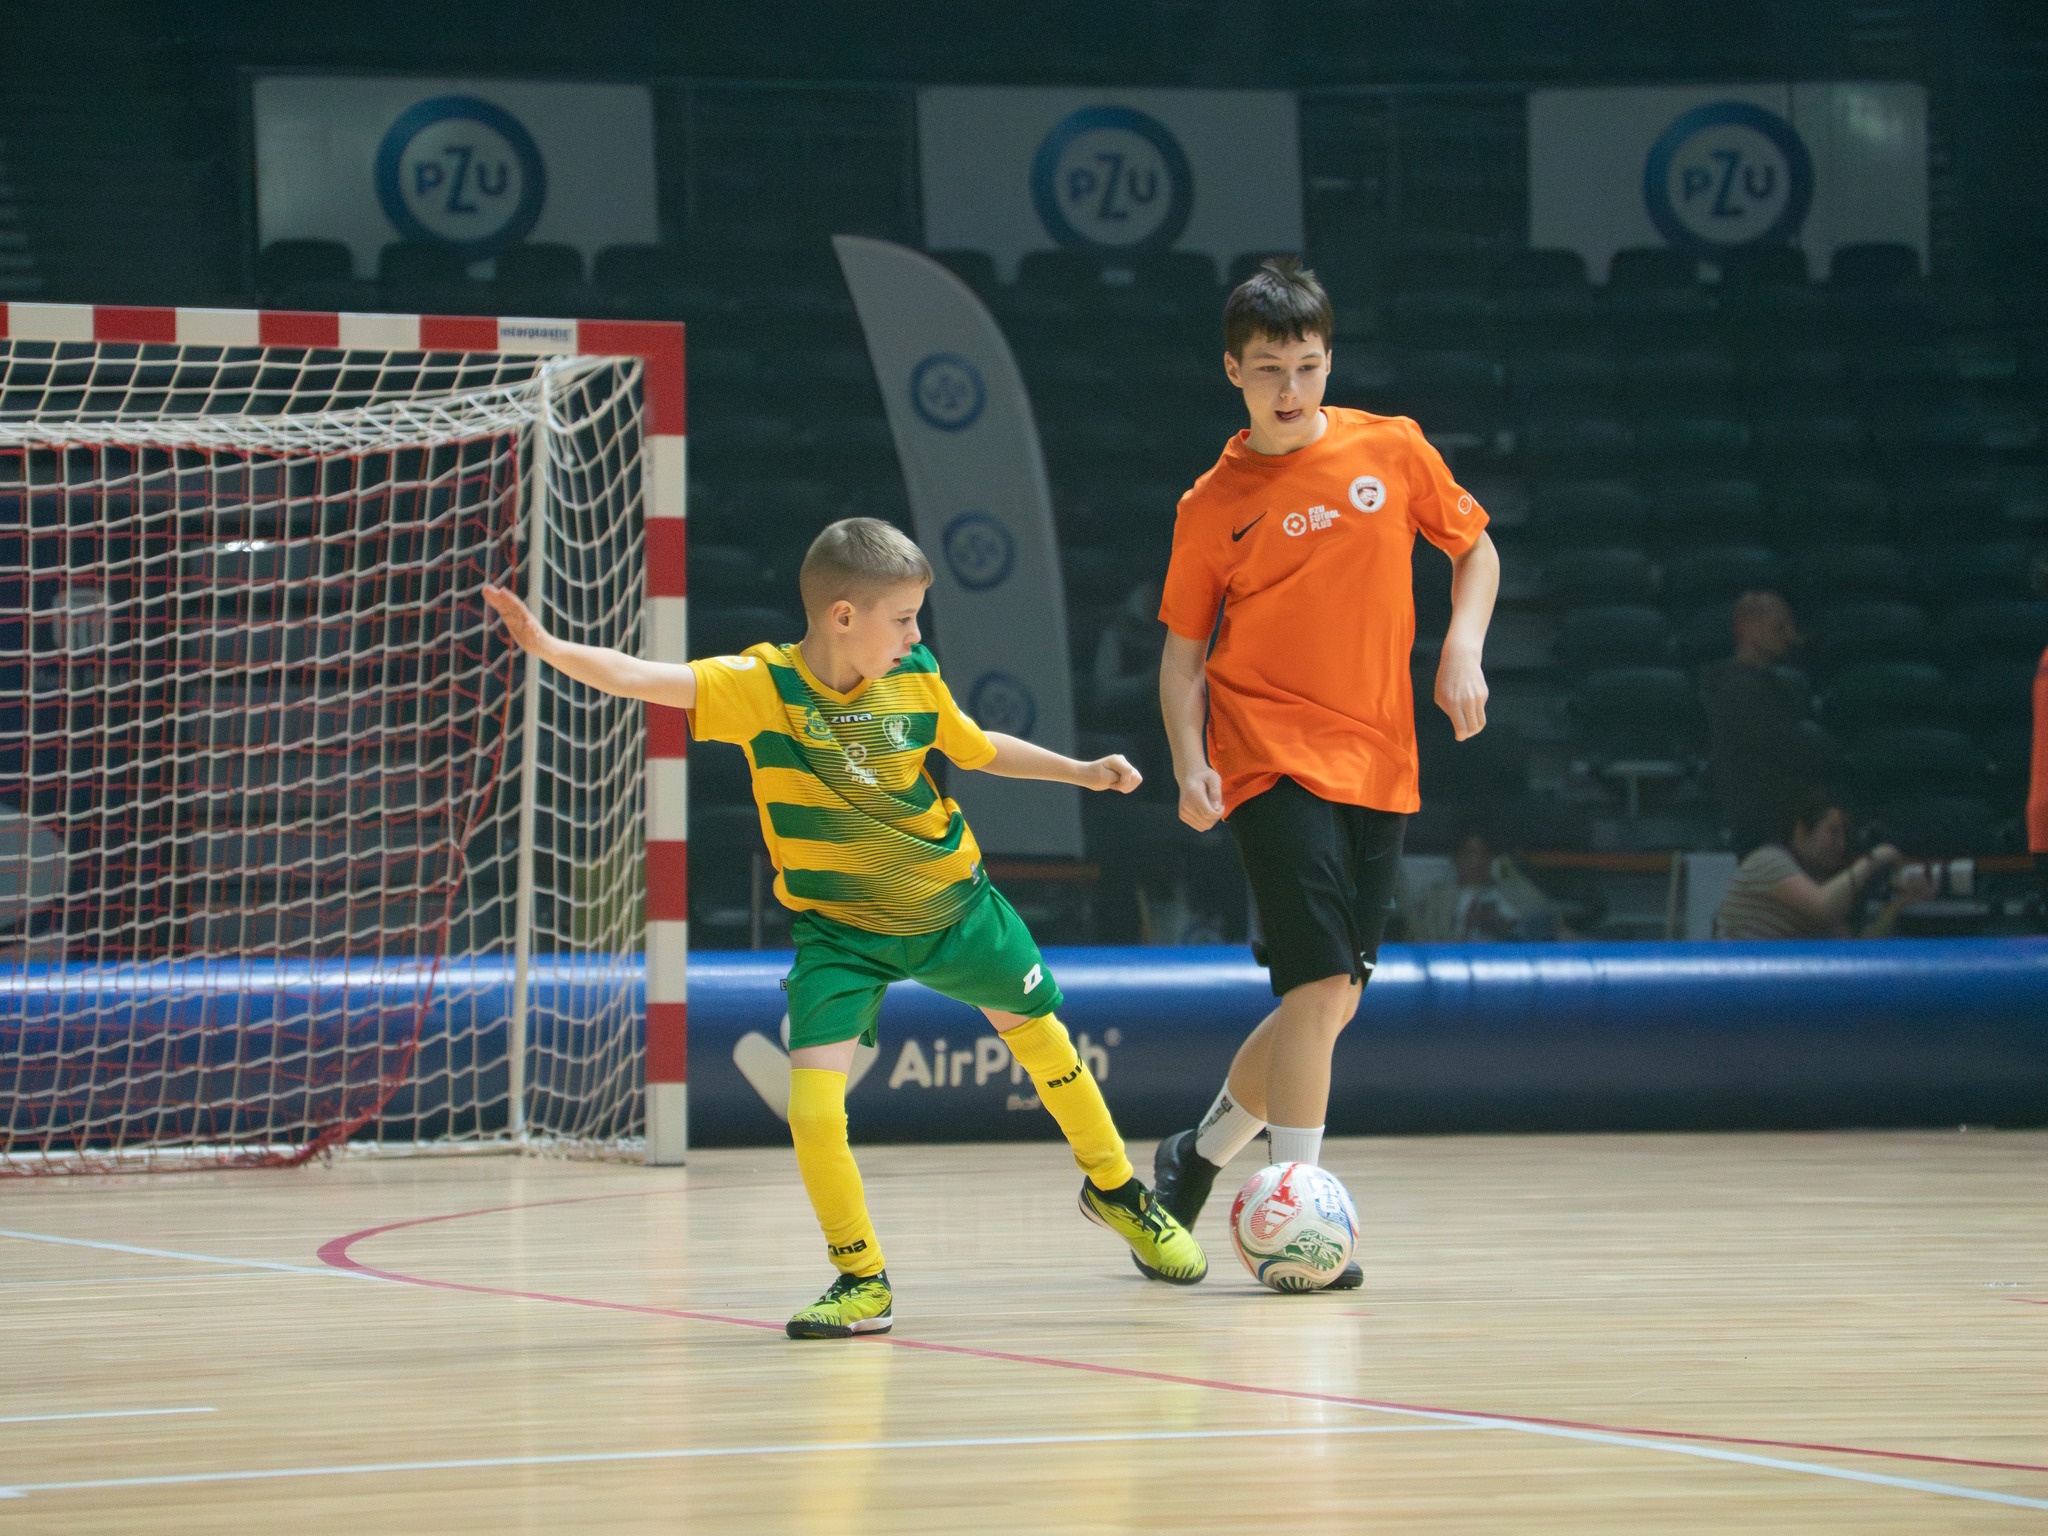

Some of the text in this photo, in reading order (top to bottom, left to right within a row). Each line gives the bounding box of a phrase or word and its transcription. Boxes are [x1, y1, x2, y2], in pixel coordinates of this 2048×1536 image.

[415, 145, 508, 215] PZU
[1067, 153, 1157, 222] PZU
[1682, 149, 1775, 218] PZU
[888, 1033, 1110, 1089] AirPh
